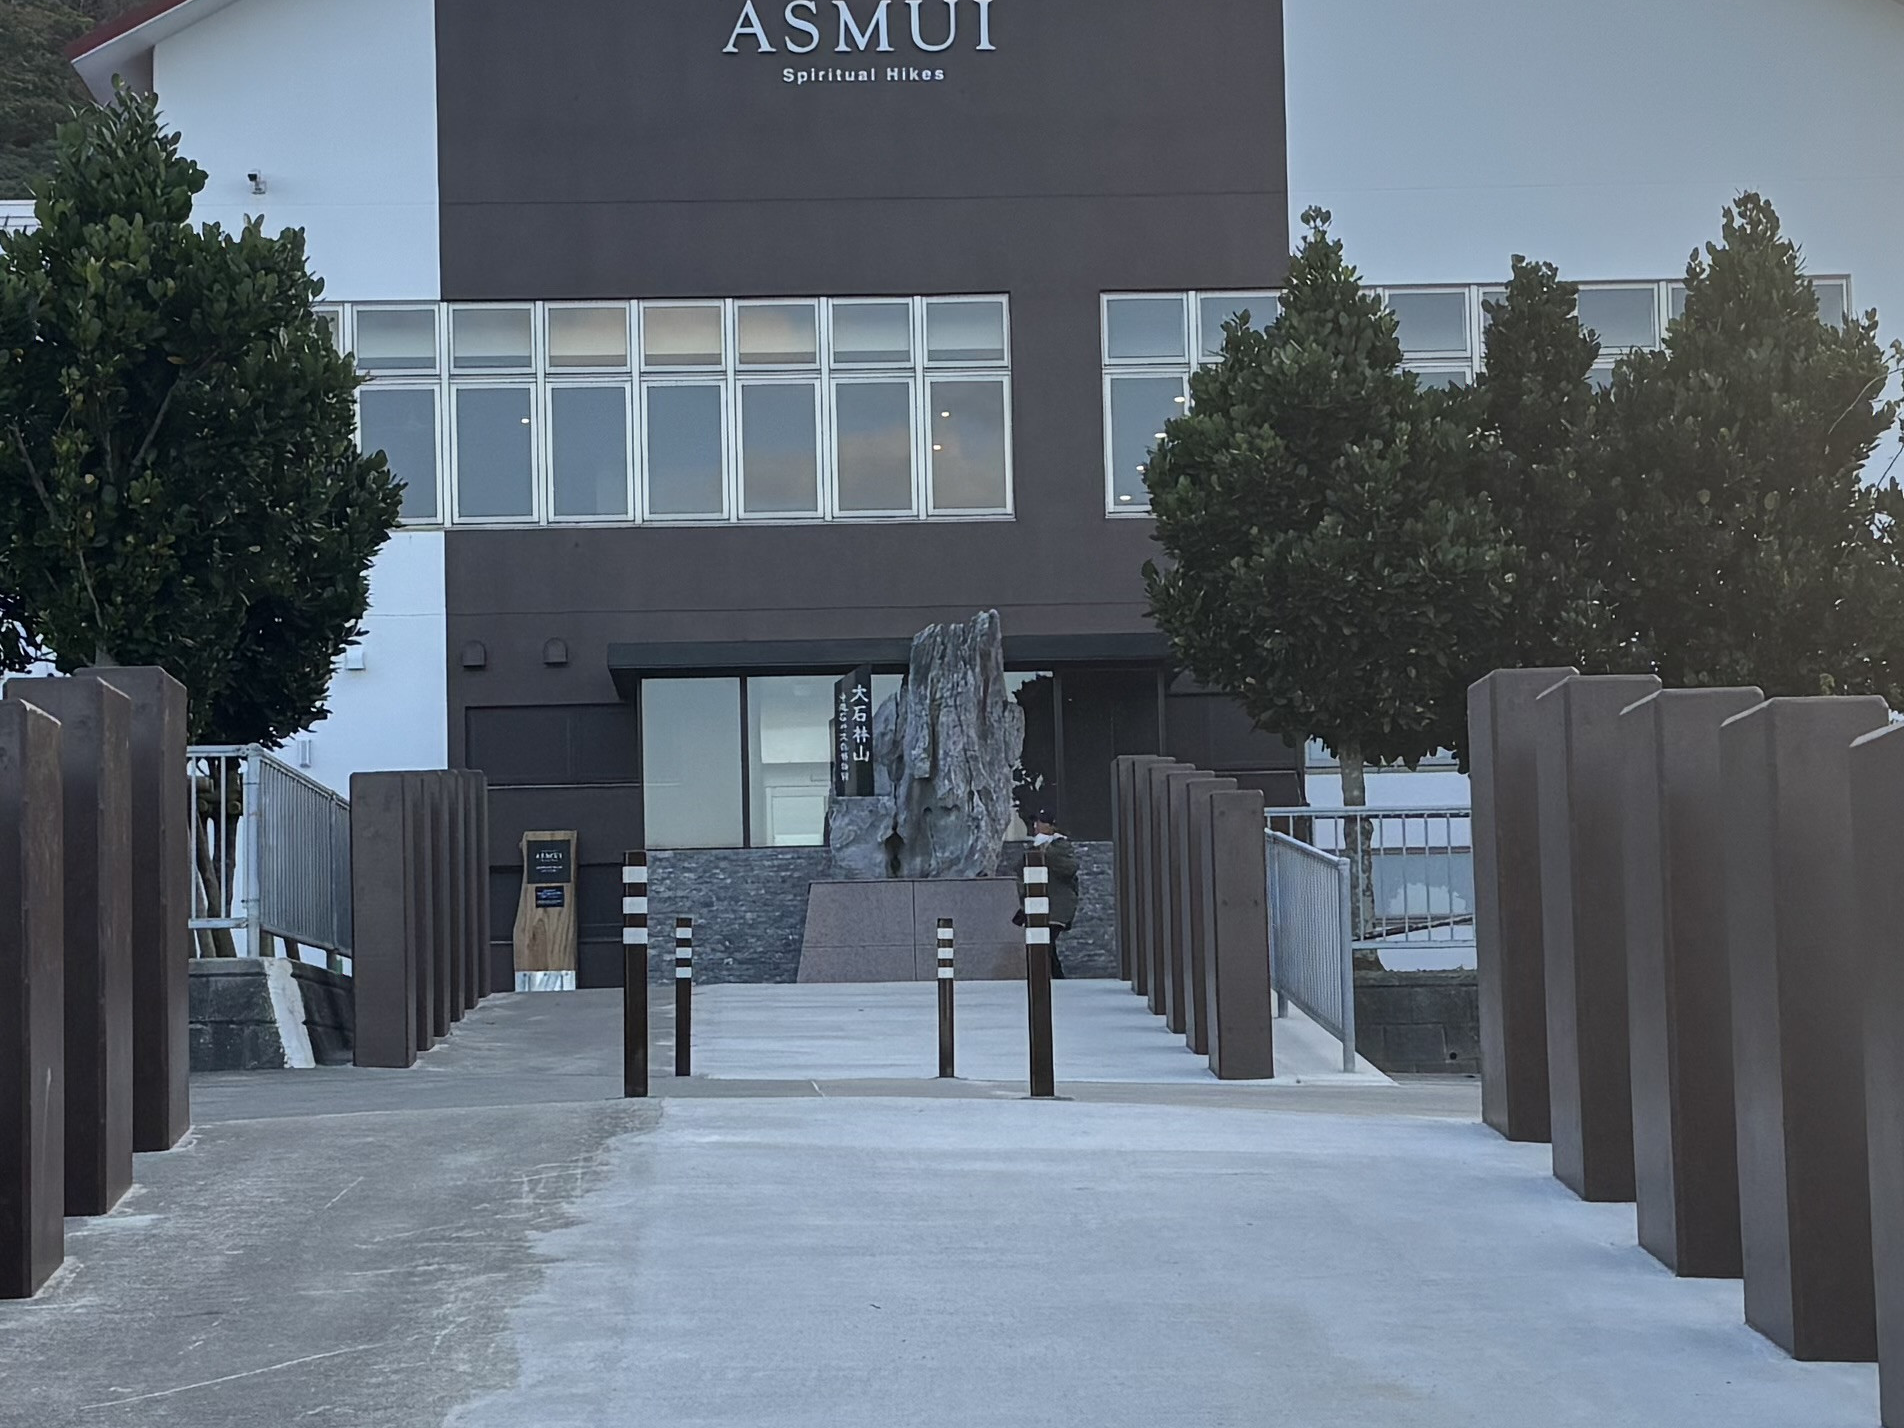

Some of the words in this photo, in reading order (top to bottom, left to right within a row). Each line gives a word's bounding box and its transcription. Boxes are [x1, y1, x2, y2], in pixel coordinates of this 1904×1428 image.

[782, 67, 876, 85] Spiritual
[886, 67, 945, 82] Hikes
[850, 683, 871, 763] 大石林山
